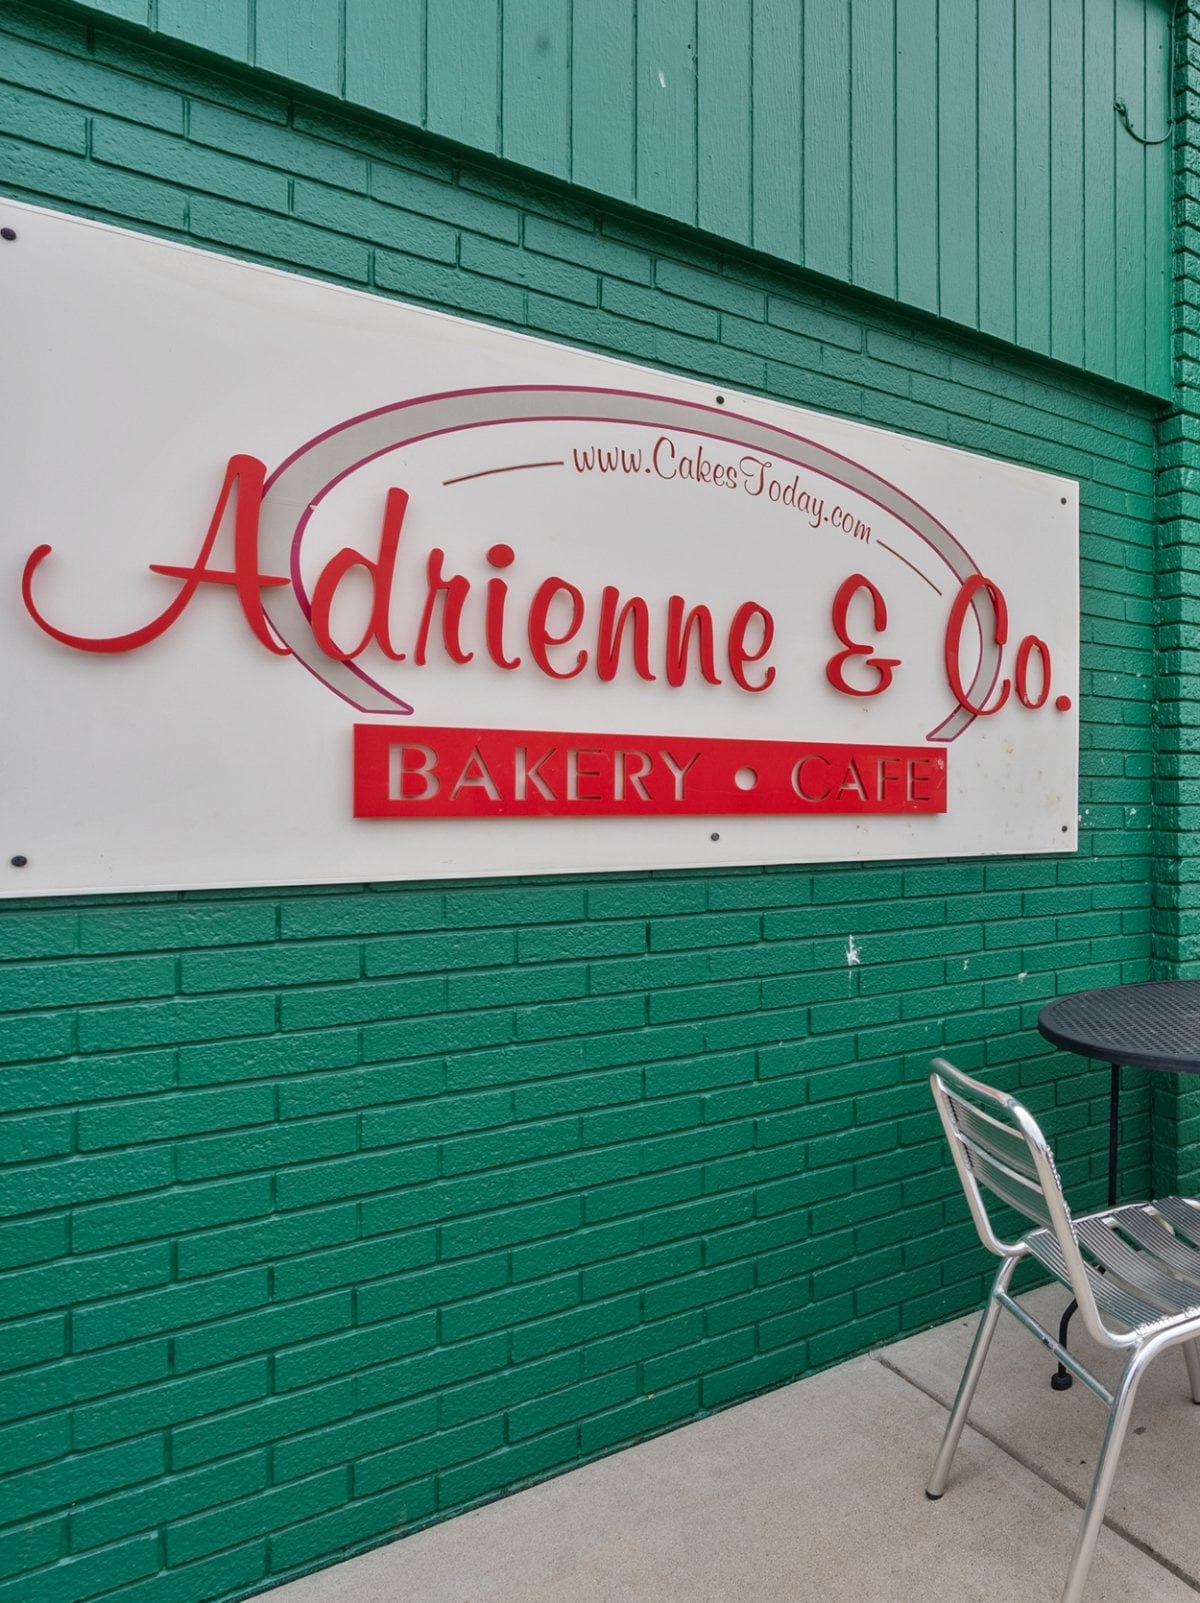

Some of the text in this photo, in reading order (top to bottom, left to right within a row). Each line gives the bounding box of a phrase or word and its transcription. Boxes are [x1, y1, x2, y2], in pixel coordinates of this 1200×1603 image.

[573, 436, 872, 545] www.CakesToday.com
[22, 453, 1073, 716] Adrienne & Co.
[387, 743, 932, 802] BAKERY CAFE
